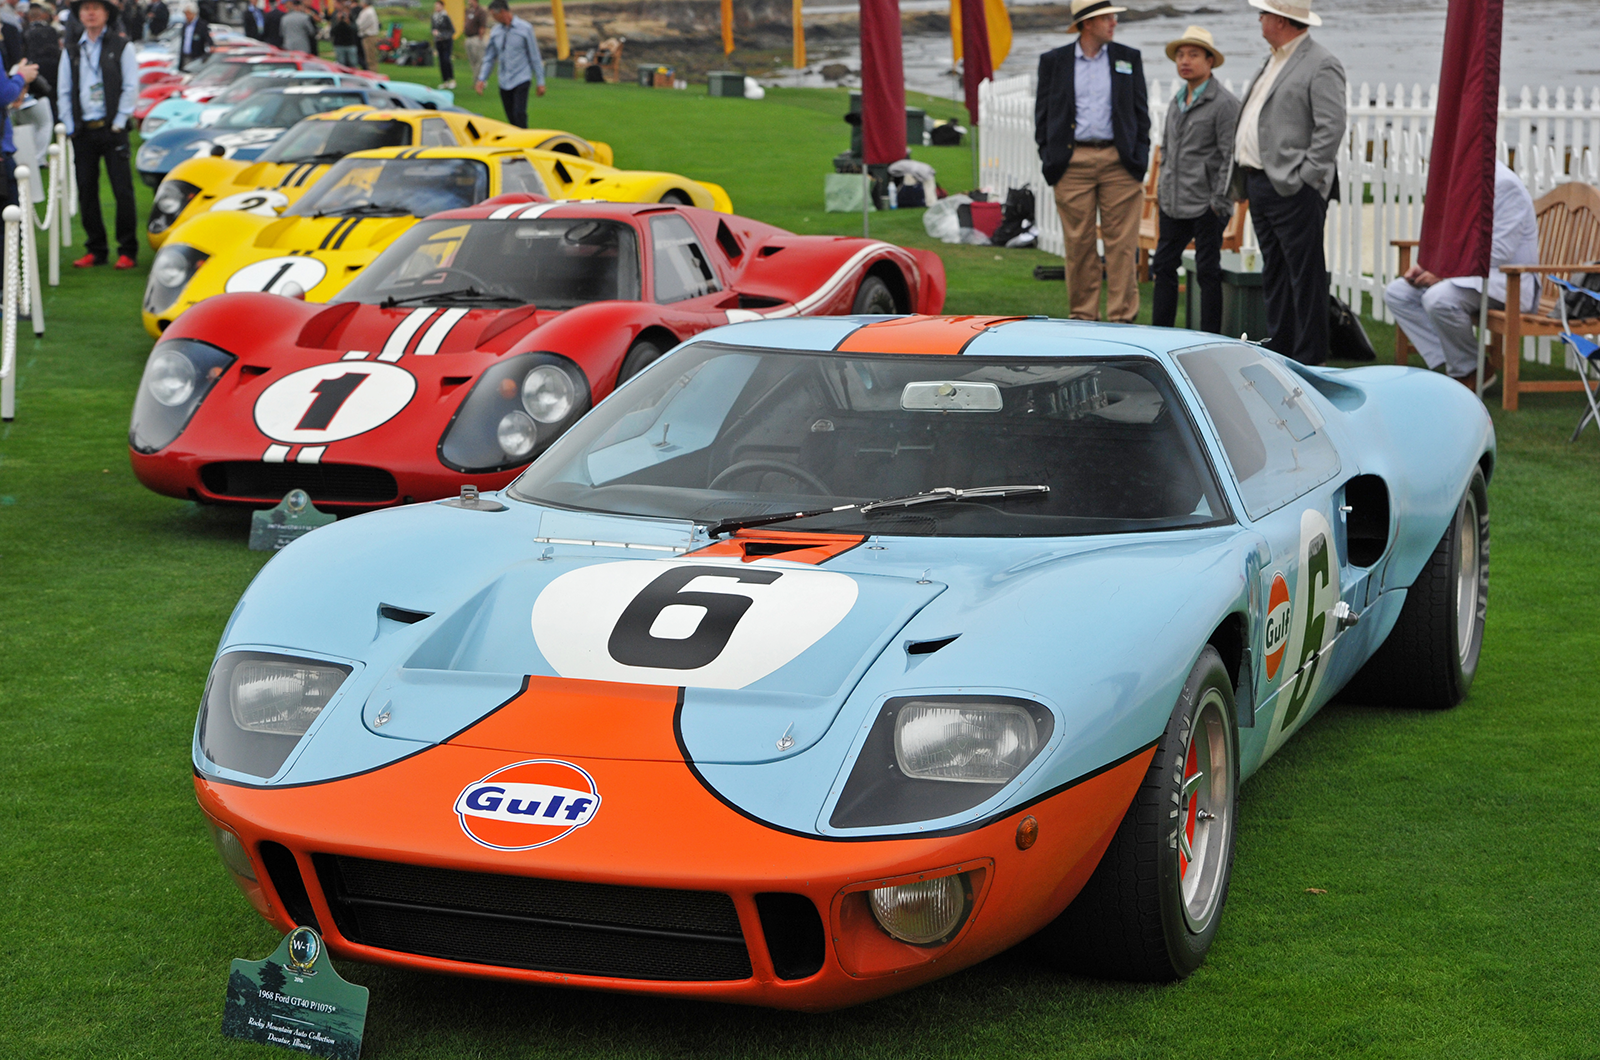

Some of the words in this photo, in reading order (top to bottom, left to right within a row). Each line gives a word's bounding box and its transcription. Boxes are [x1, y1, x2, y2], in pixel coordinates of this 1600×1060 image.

[237, 196, 267, 211] 2
[261, 262, 294, 292] 1
[294, 372, 371, 431] 1
[607, 565, 783, 670] 6
[1265, 607, 1290, 649] Gulf
[1281, 532, 1329, 732] 6
[465, 786, 593, 820] Gulf
[293, 939, 315, 953] W-11
[258, 989, 274, 1000] 1968
[274, 992, 290, 1004] Ford
[290, 996, 310, 1008] GT40
[248, 1016, 265, 1029] Rocky
[265, 1021, 293, 1035] Mountain
[293, 1028, 308, 1038] Auto
[308, 1031, 336, 1045] Collection
[292, 1037, 312, 1050] Illinois
